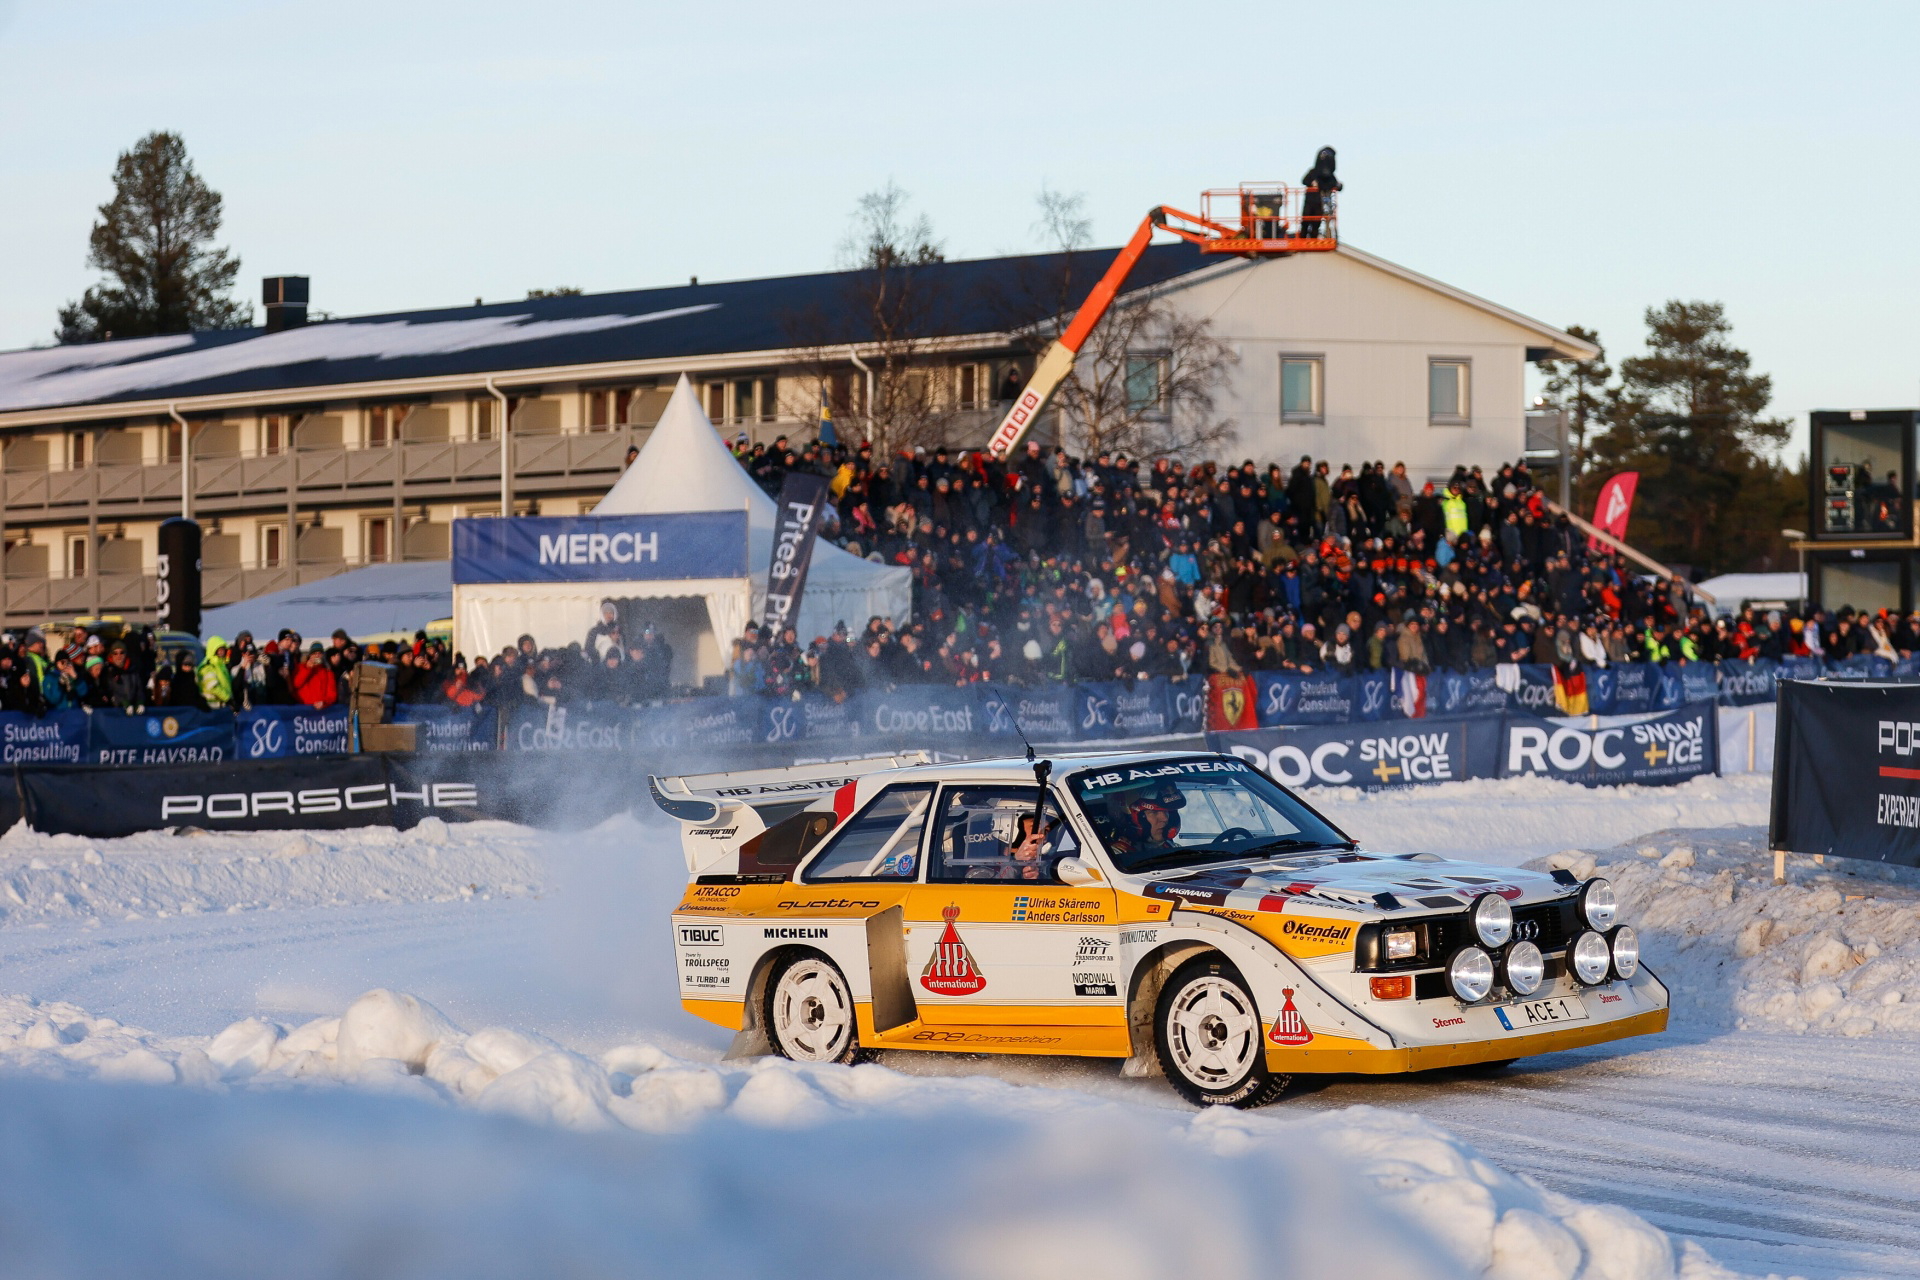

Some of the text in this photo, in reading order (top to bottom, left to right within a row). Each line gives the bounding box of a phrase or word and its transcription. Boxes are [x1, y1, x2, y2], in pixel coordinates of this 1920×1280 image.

[538, 531, 658, 566] MERCH
[772, 501, 815, 581] Piteå
[1299, 679, 1339, 697] Student
[1017, 698, 1060, 716] Student
[1116, 694, 1151, 711] Student
[1297, 694, 1350, 714] Consulting
[293, 715, 349, 735] Student
[1114, 710, 1165, 729] Consulting
[4, 722, 61, 743] Student
[1630, 715, 1705, 745] SNOW
[3, 741, 81, 764] Consulting
[142, 746, 224, 765] HAVSBAD
[1359, 731, 1449, 762] SNOW
[1508, 726, 1627, 772] ROC
[1666, 737, 1703, 766] ICE
[1401, 752, 1452, 782] ICE
[1565, 769, 1627, 783] CHAMPIONS
[1082, 771, 1123, 791] HB
[715, 787, 753, 797] HB
[161, 782, 478, 821] PORSCHE
[693, 886, 741, 897] ATRACCO
[1164, 886, 1214, 899] HAGMANS
[776, 898, 881, 911] quattro
[1029, 897, 1101, 910] Ulrika Skäremo
[1026, 910, 1106, 923] Anders Carlsson
[1228, 910, 1255, 922] Sport
[681, 929, 720, 942] TIBUC
[763, 928, 829, 939] MICHELIN
[1291, 935, 1346, 946] MOTOR OIL
[1295, 922, 1352, 941] Kendall
[685, 958, 730, 968] TROLLSPEED
[934, 942, 969, 978] HB
[696, 975, 718, 984] TURBO
[720, 976, 730, 984] AB
[928, 978, 979, 990] international
[1072, 972, 1116, 985] NORDWALL
[1085, 986, 1107, 995] MARIN
[1525, 1001, 1558, 1024] ACE
[1560, 999, 1572, 1018] 1
[1277, 1009, 1302, 1034] HB
[1432, 1017, 1466, 1029] Stema.
[912, 1030, 1062, 1045] ace Competition
[1273, 1033, 1309, 1042] international
[1201, 1087, 1249, 1105] MICHELIN
